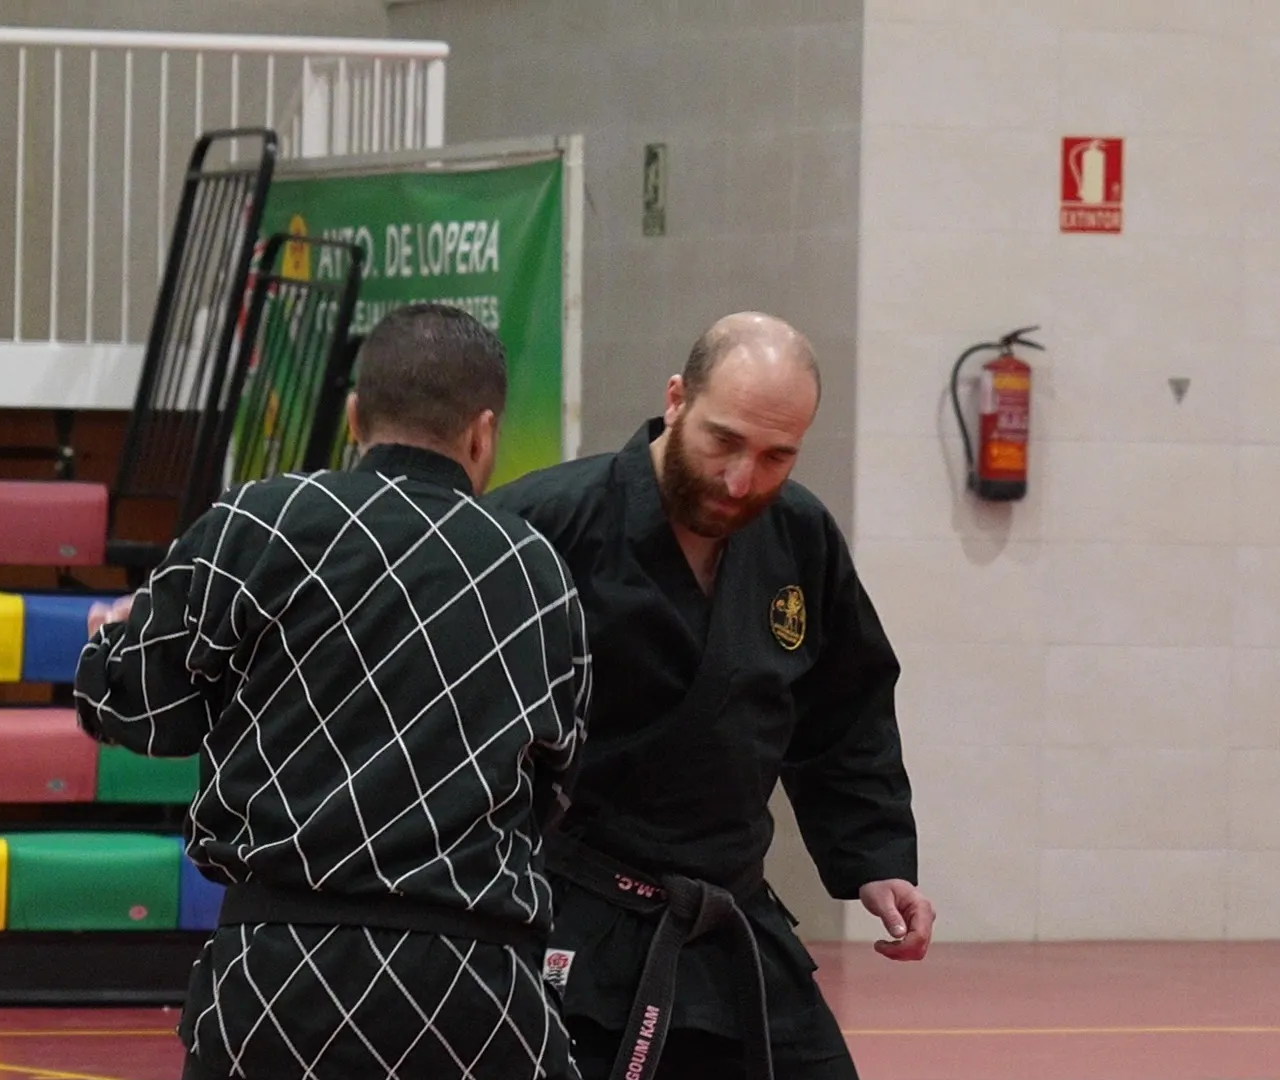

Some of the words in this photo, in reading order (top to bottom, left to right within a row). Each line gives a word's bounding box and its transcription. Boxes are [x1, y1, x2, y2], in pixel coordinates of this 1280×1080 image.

[384, 222, 413, 278] DE
[417, 218, 500, 277] LOPERA
[639, 1004, 660, 1038] KAM
